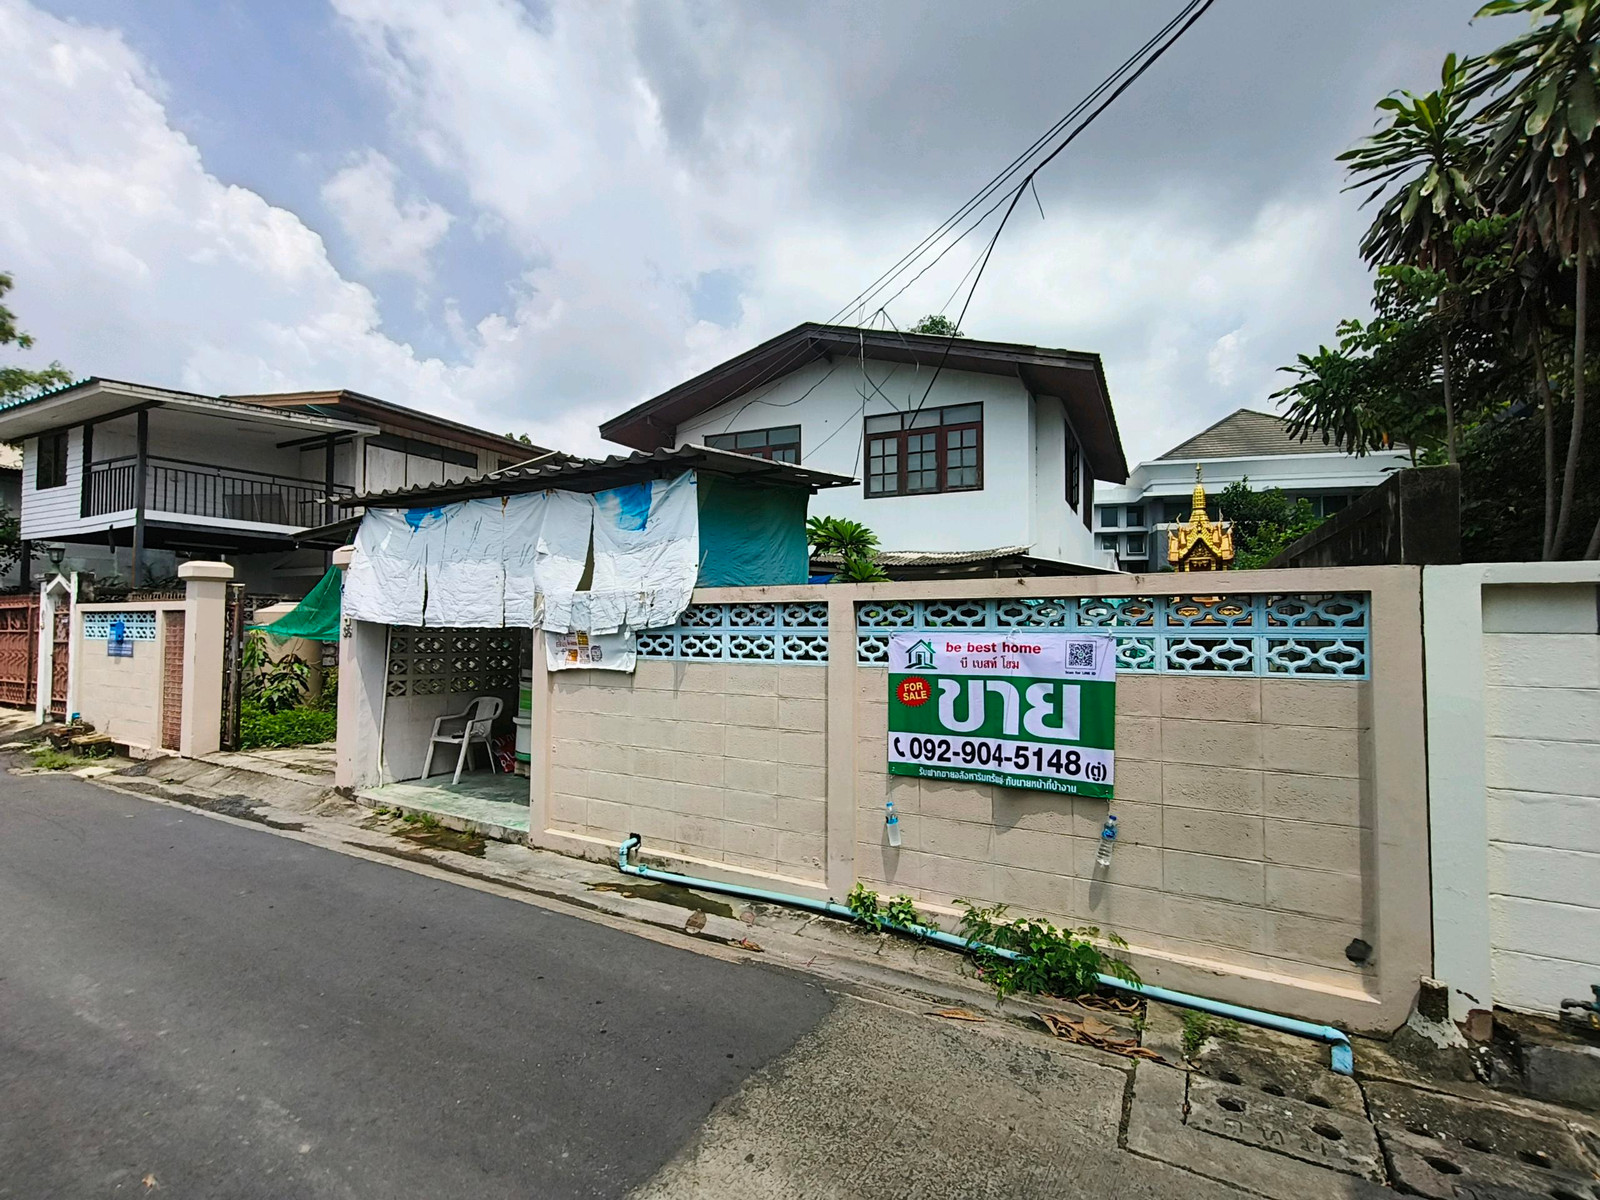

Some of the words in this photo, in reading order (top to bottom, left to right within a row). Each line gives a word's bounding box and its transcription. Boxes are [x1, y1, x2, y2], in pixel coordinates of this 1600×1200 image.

[945, 641, 962, 653] be
[967, 641, 997, 653] best
[1002, 641, 1042, 655] home
[972, 655, 998, 669] เบสท์
[903, 682, 923, 692] FOR
[903, 690, 928, 701] SALE
[937, 678, 1081, 741] ขาย
[909, 736, 1081, 776] 092-904-5148
[1085, 761, 1107, 782] (ตู่)
